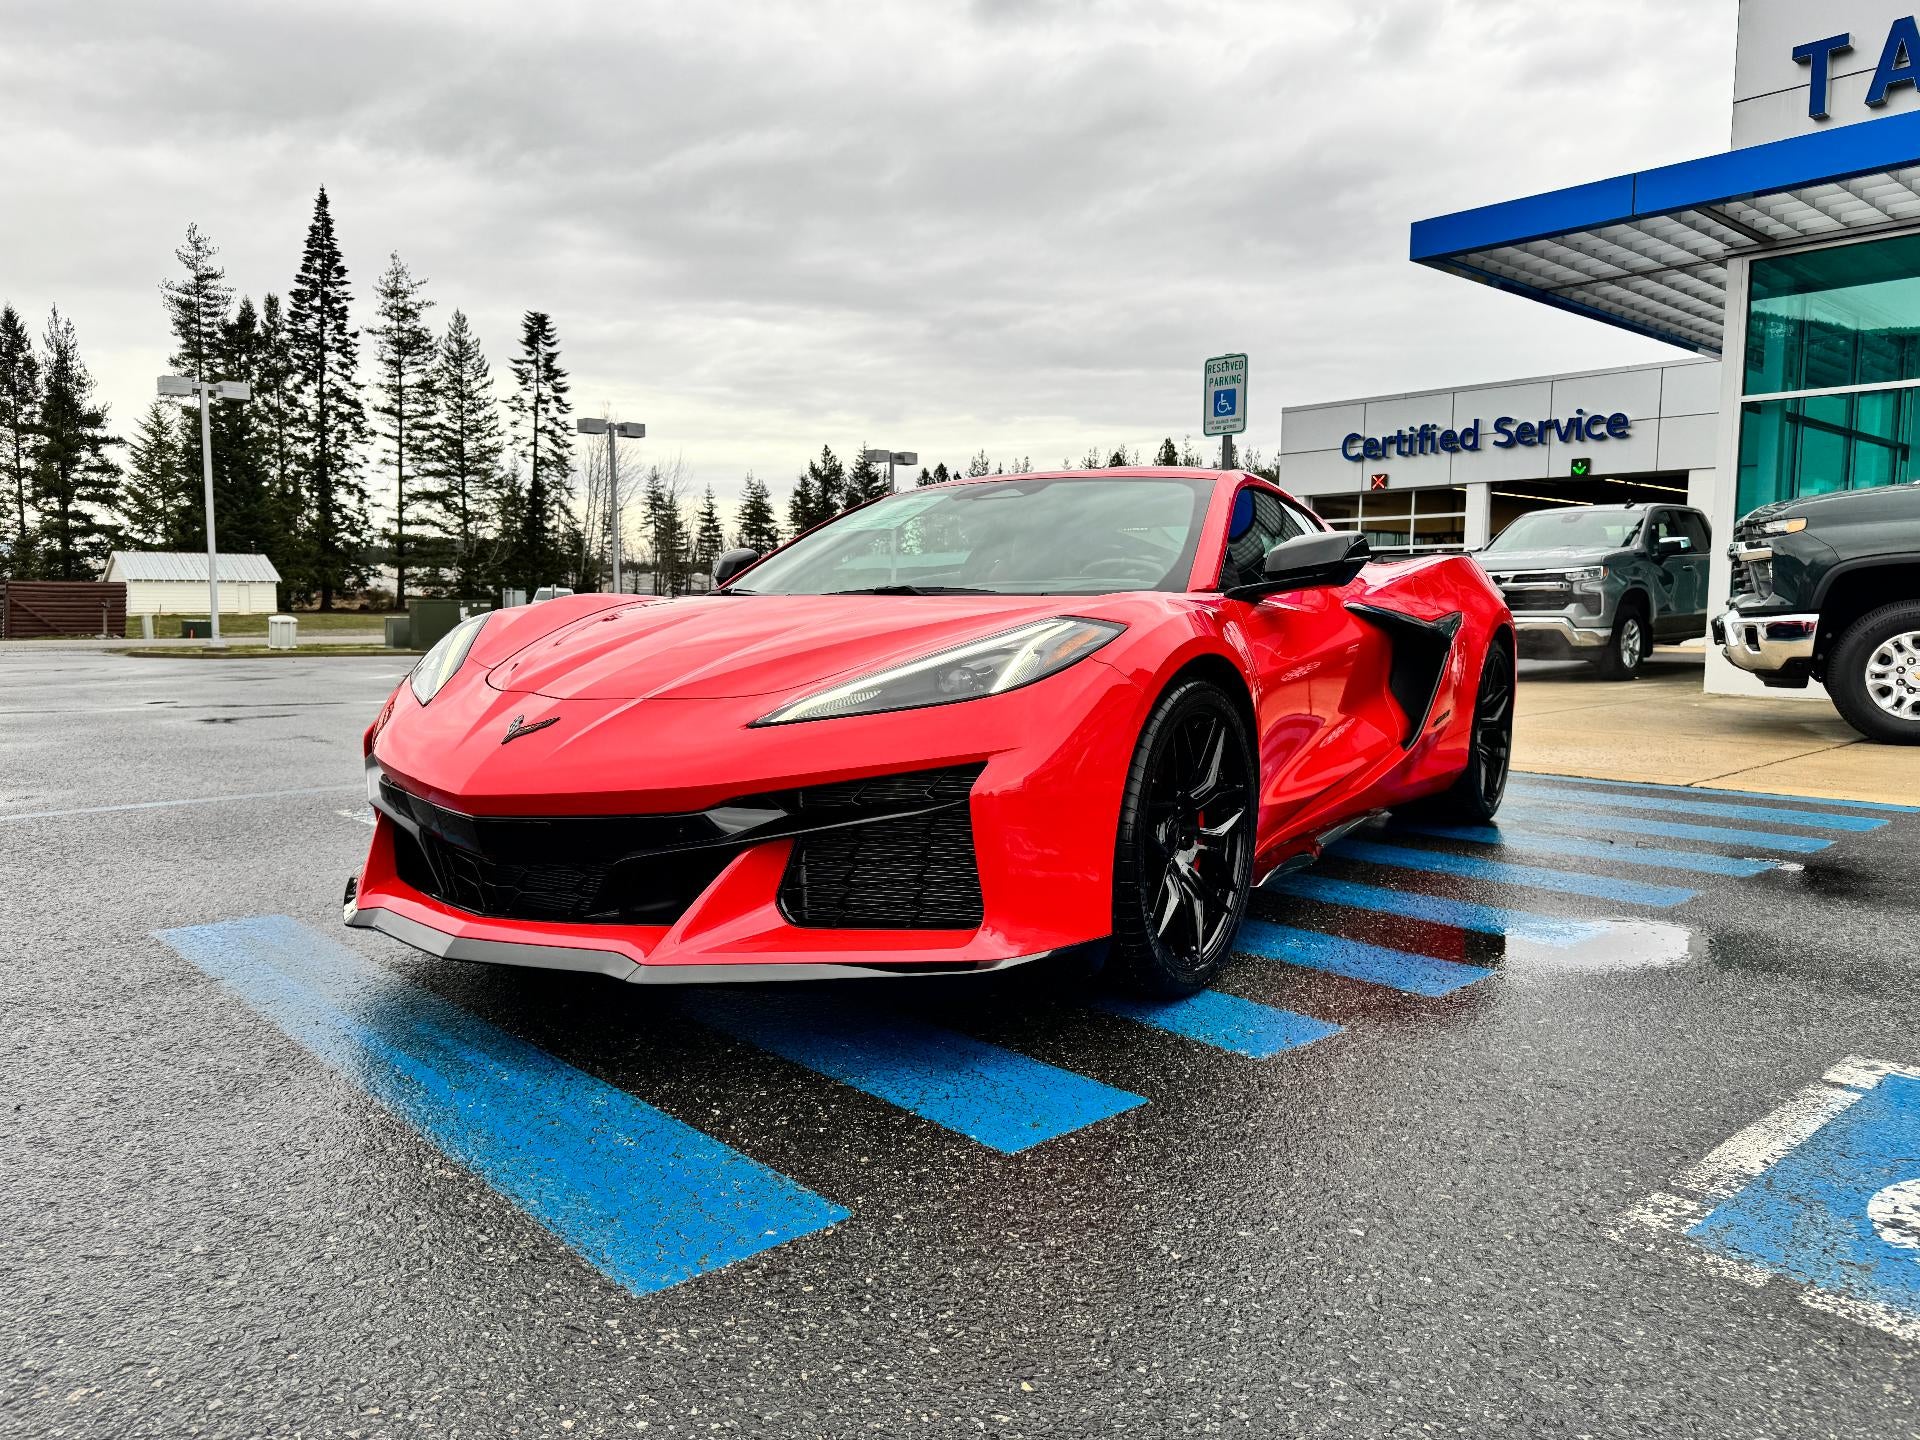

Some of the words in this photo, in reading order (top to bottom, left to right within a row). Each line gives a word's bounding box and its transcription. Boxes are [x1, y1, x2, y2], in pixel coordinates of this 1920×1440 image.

[1208, 360, 1244, 374] RESERVED
[1209, 374, 1242, 387] PARKING
[1342, 418, 1480, 462] Certified
[1493, 408, 1630, 448] Service
